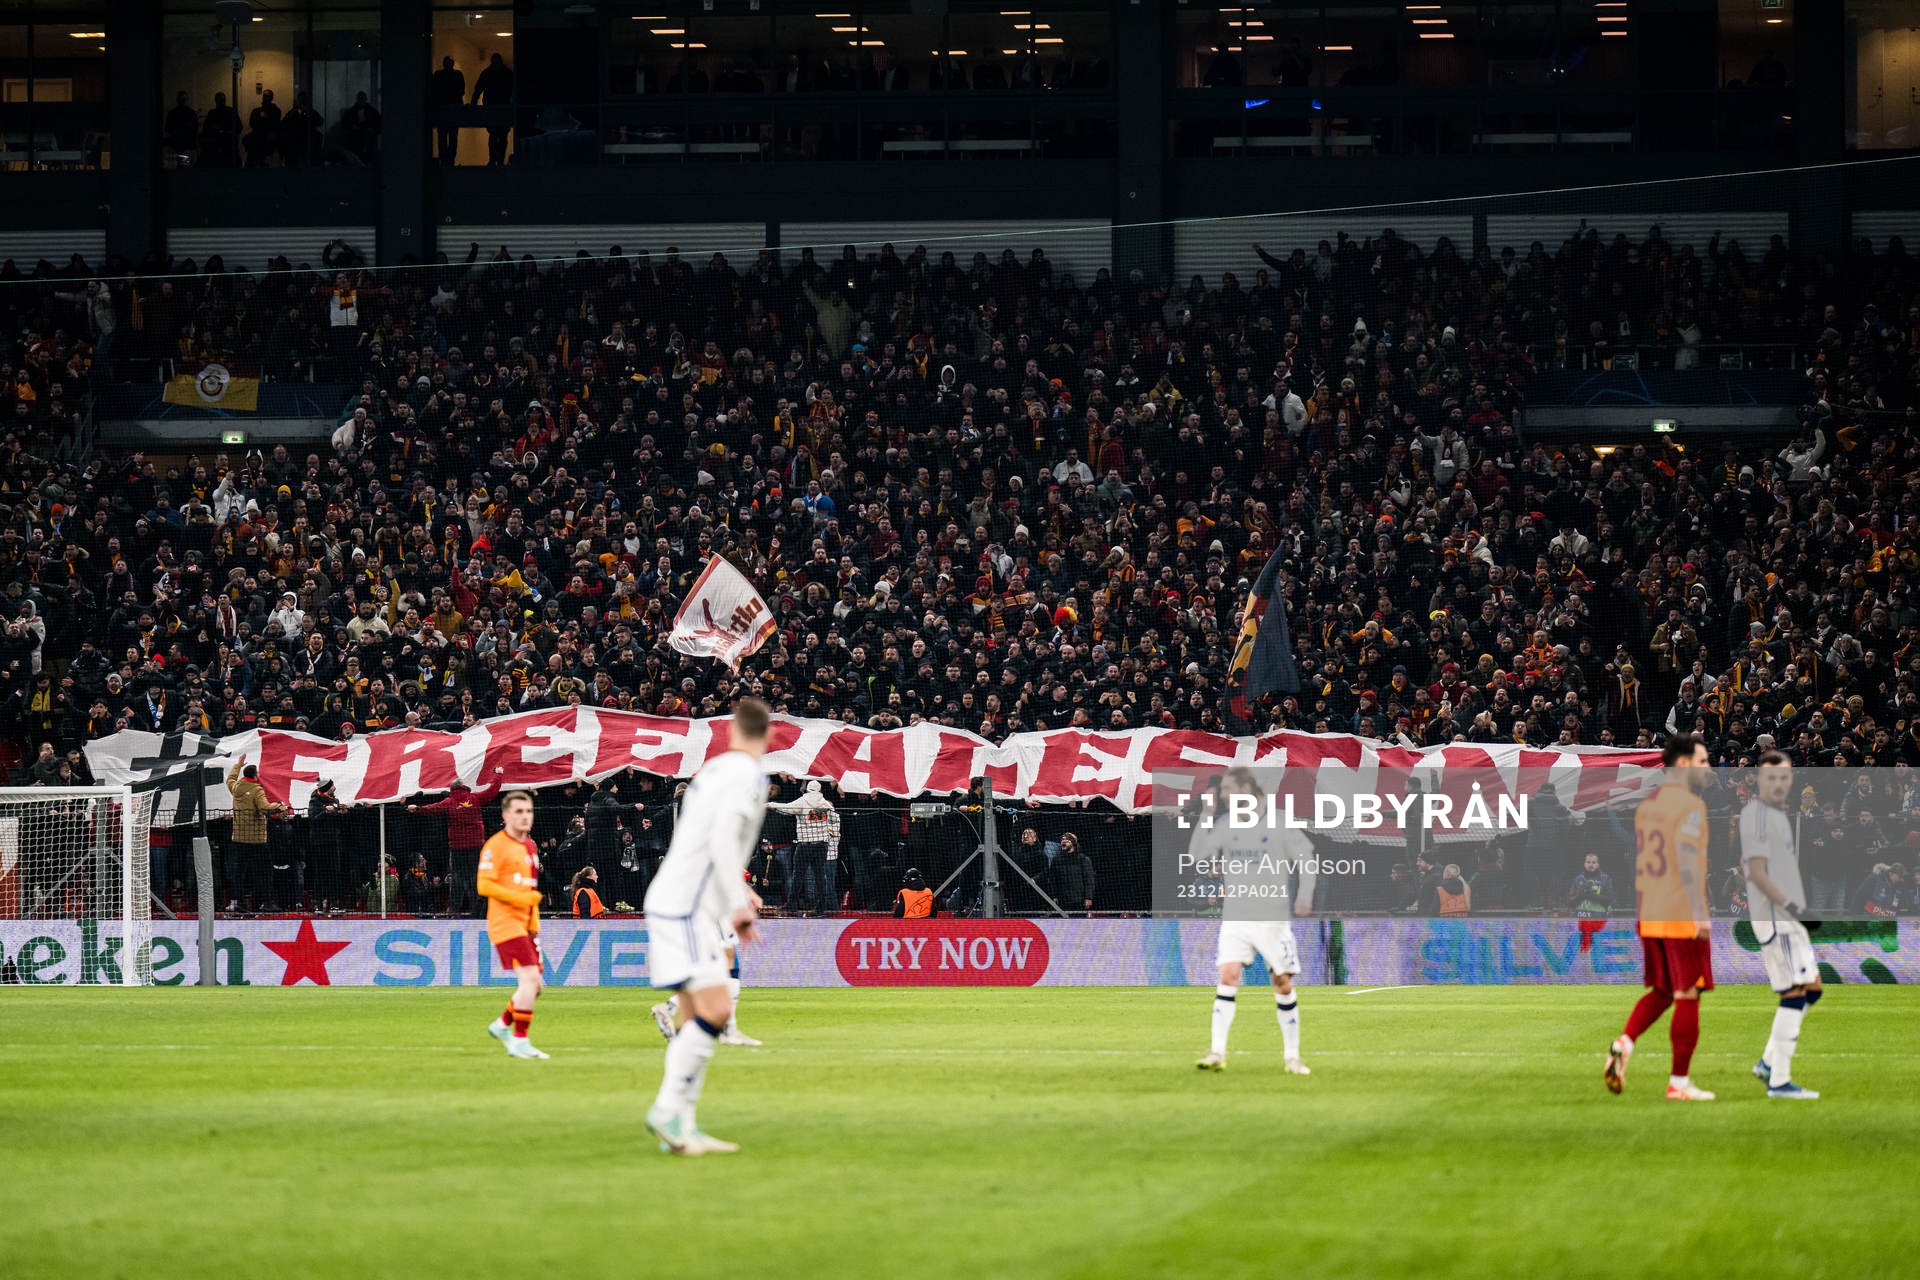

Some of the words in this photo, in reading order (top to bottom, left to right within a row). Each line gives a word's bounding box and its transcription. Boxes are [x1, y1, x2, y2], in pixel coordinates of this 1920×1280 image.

[0, 919, 251, 986] eken
[376, 929, 738, 986] SILVE
[851, 937, 928, 970] TRY
[938, 937, 1033, 970] NOW
[1420, 929, 1638, 983] SILVE
